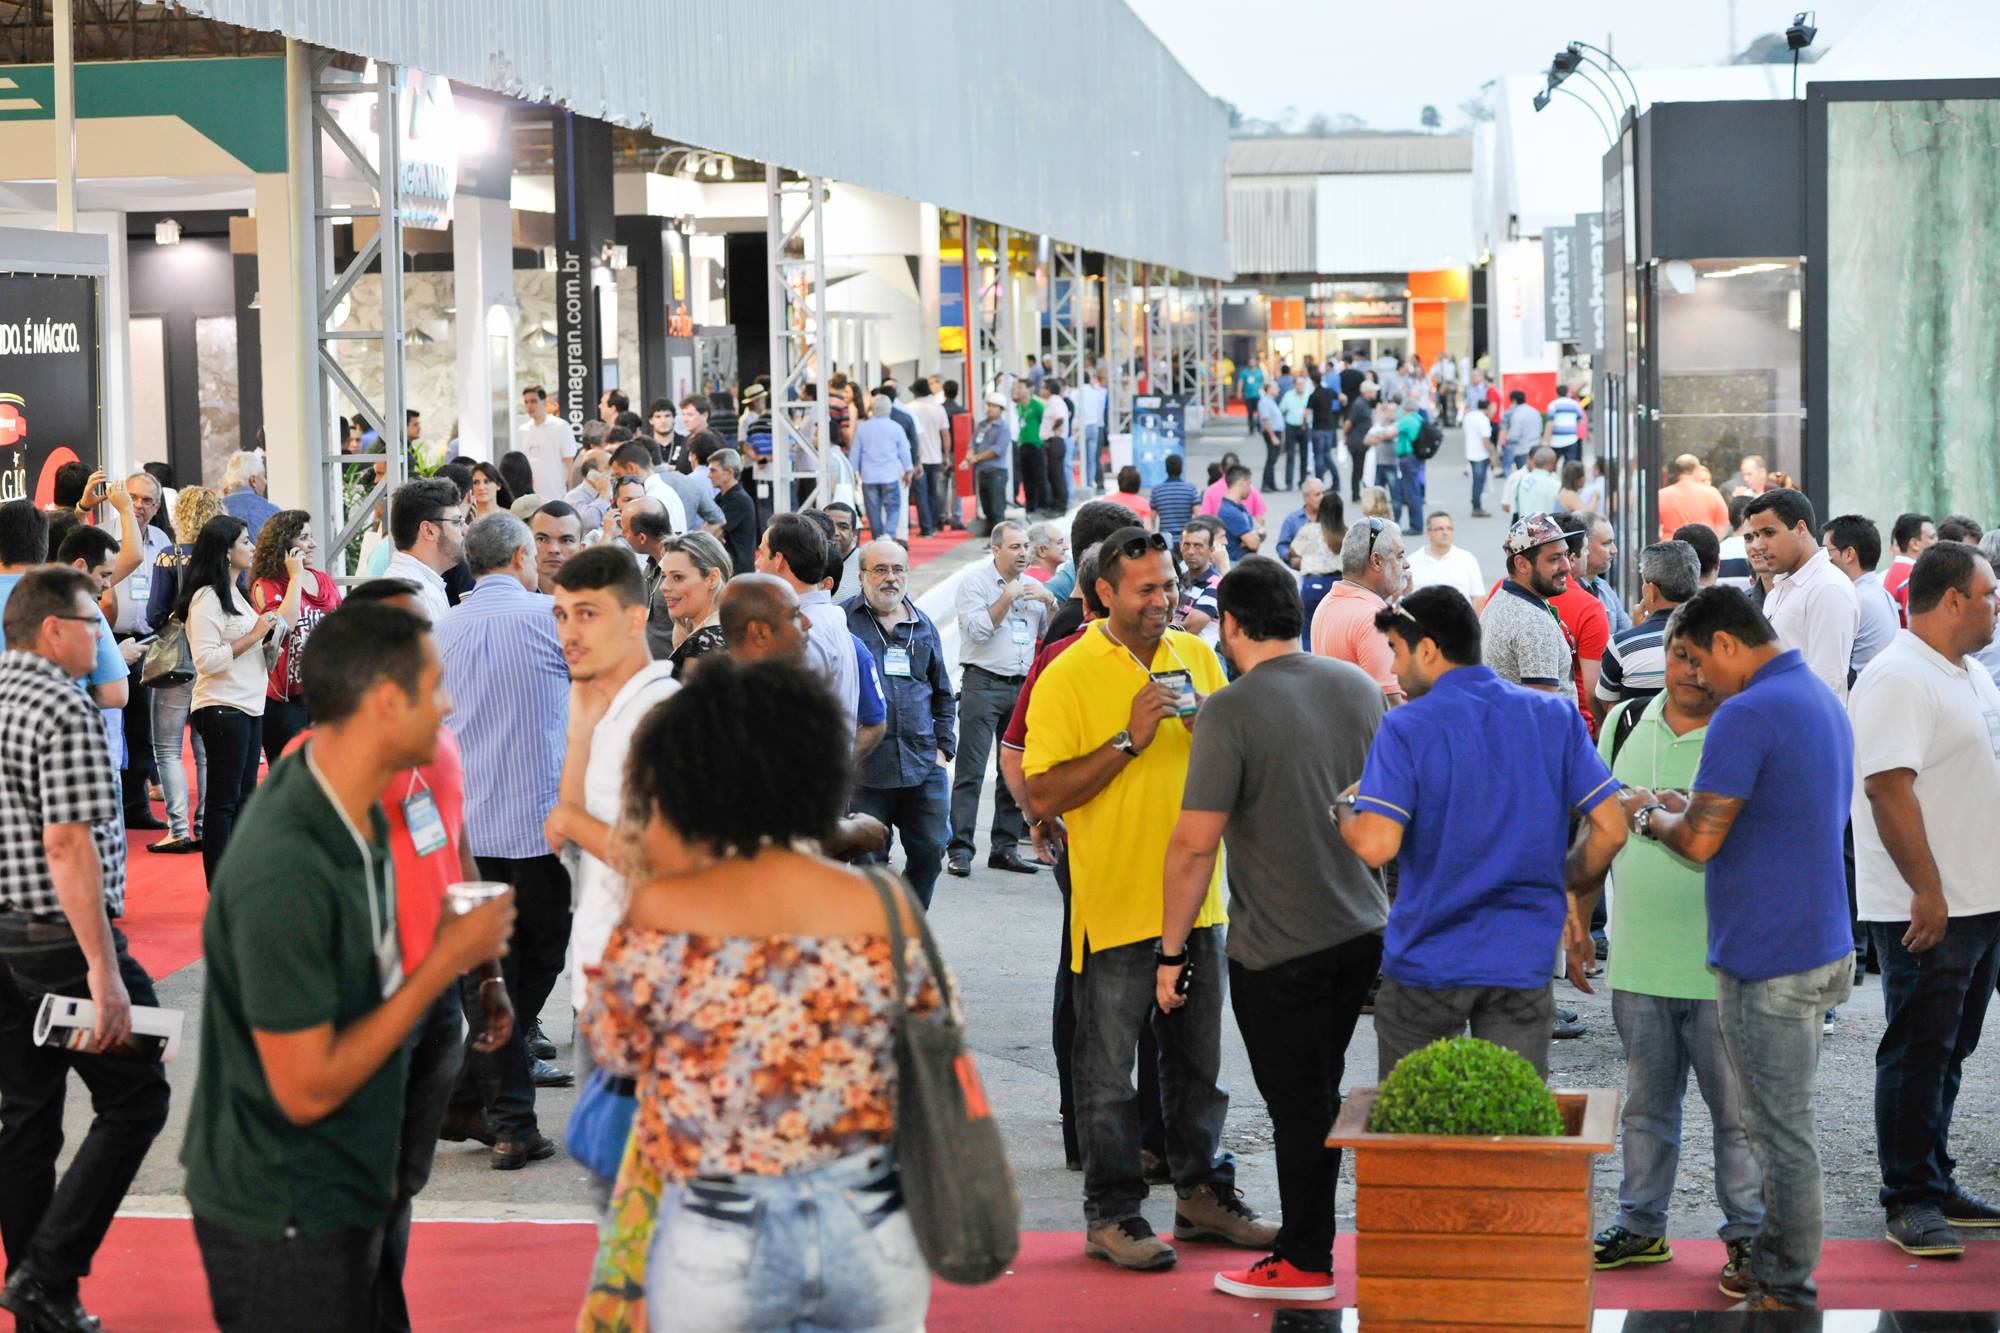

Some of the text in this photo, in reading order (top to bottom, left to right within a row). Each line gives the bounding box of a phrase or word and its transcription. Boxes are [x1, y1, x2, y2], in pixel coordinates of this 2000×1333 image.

[1551, 234, 1571, 339] nebrax
[0, 317, 80, 355] DO. É MÁGICO.
[0, 468, 27, 502] GIC
